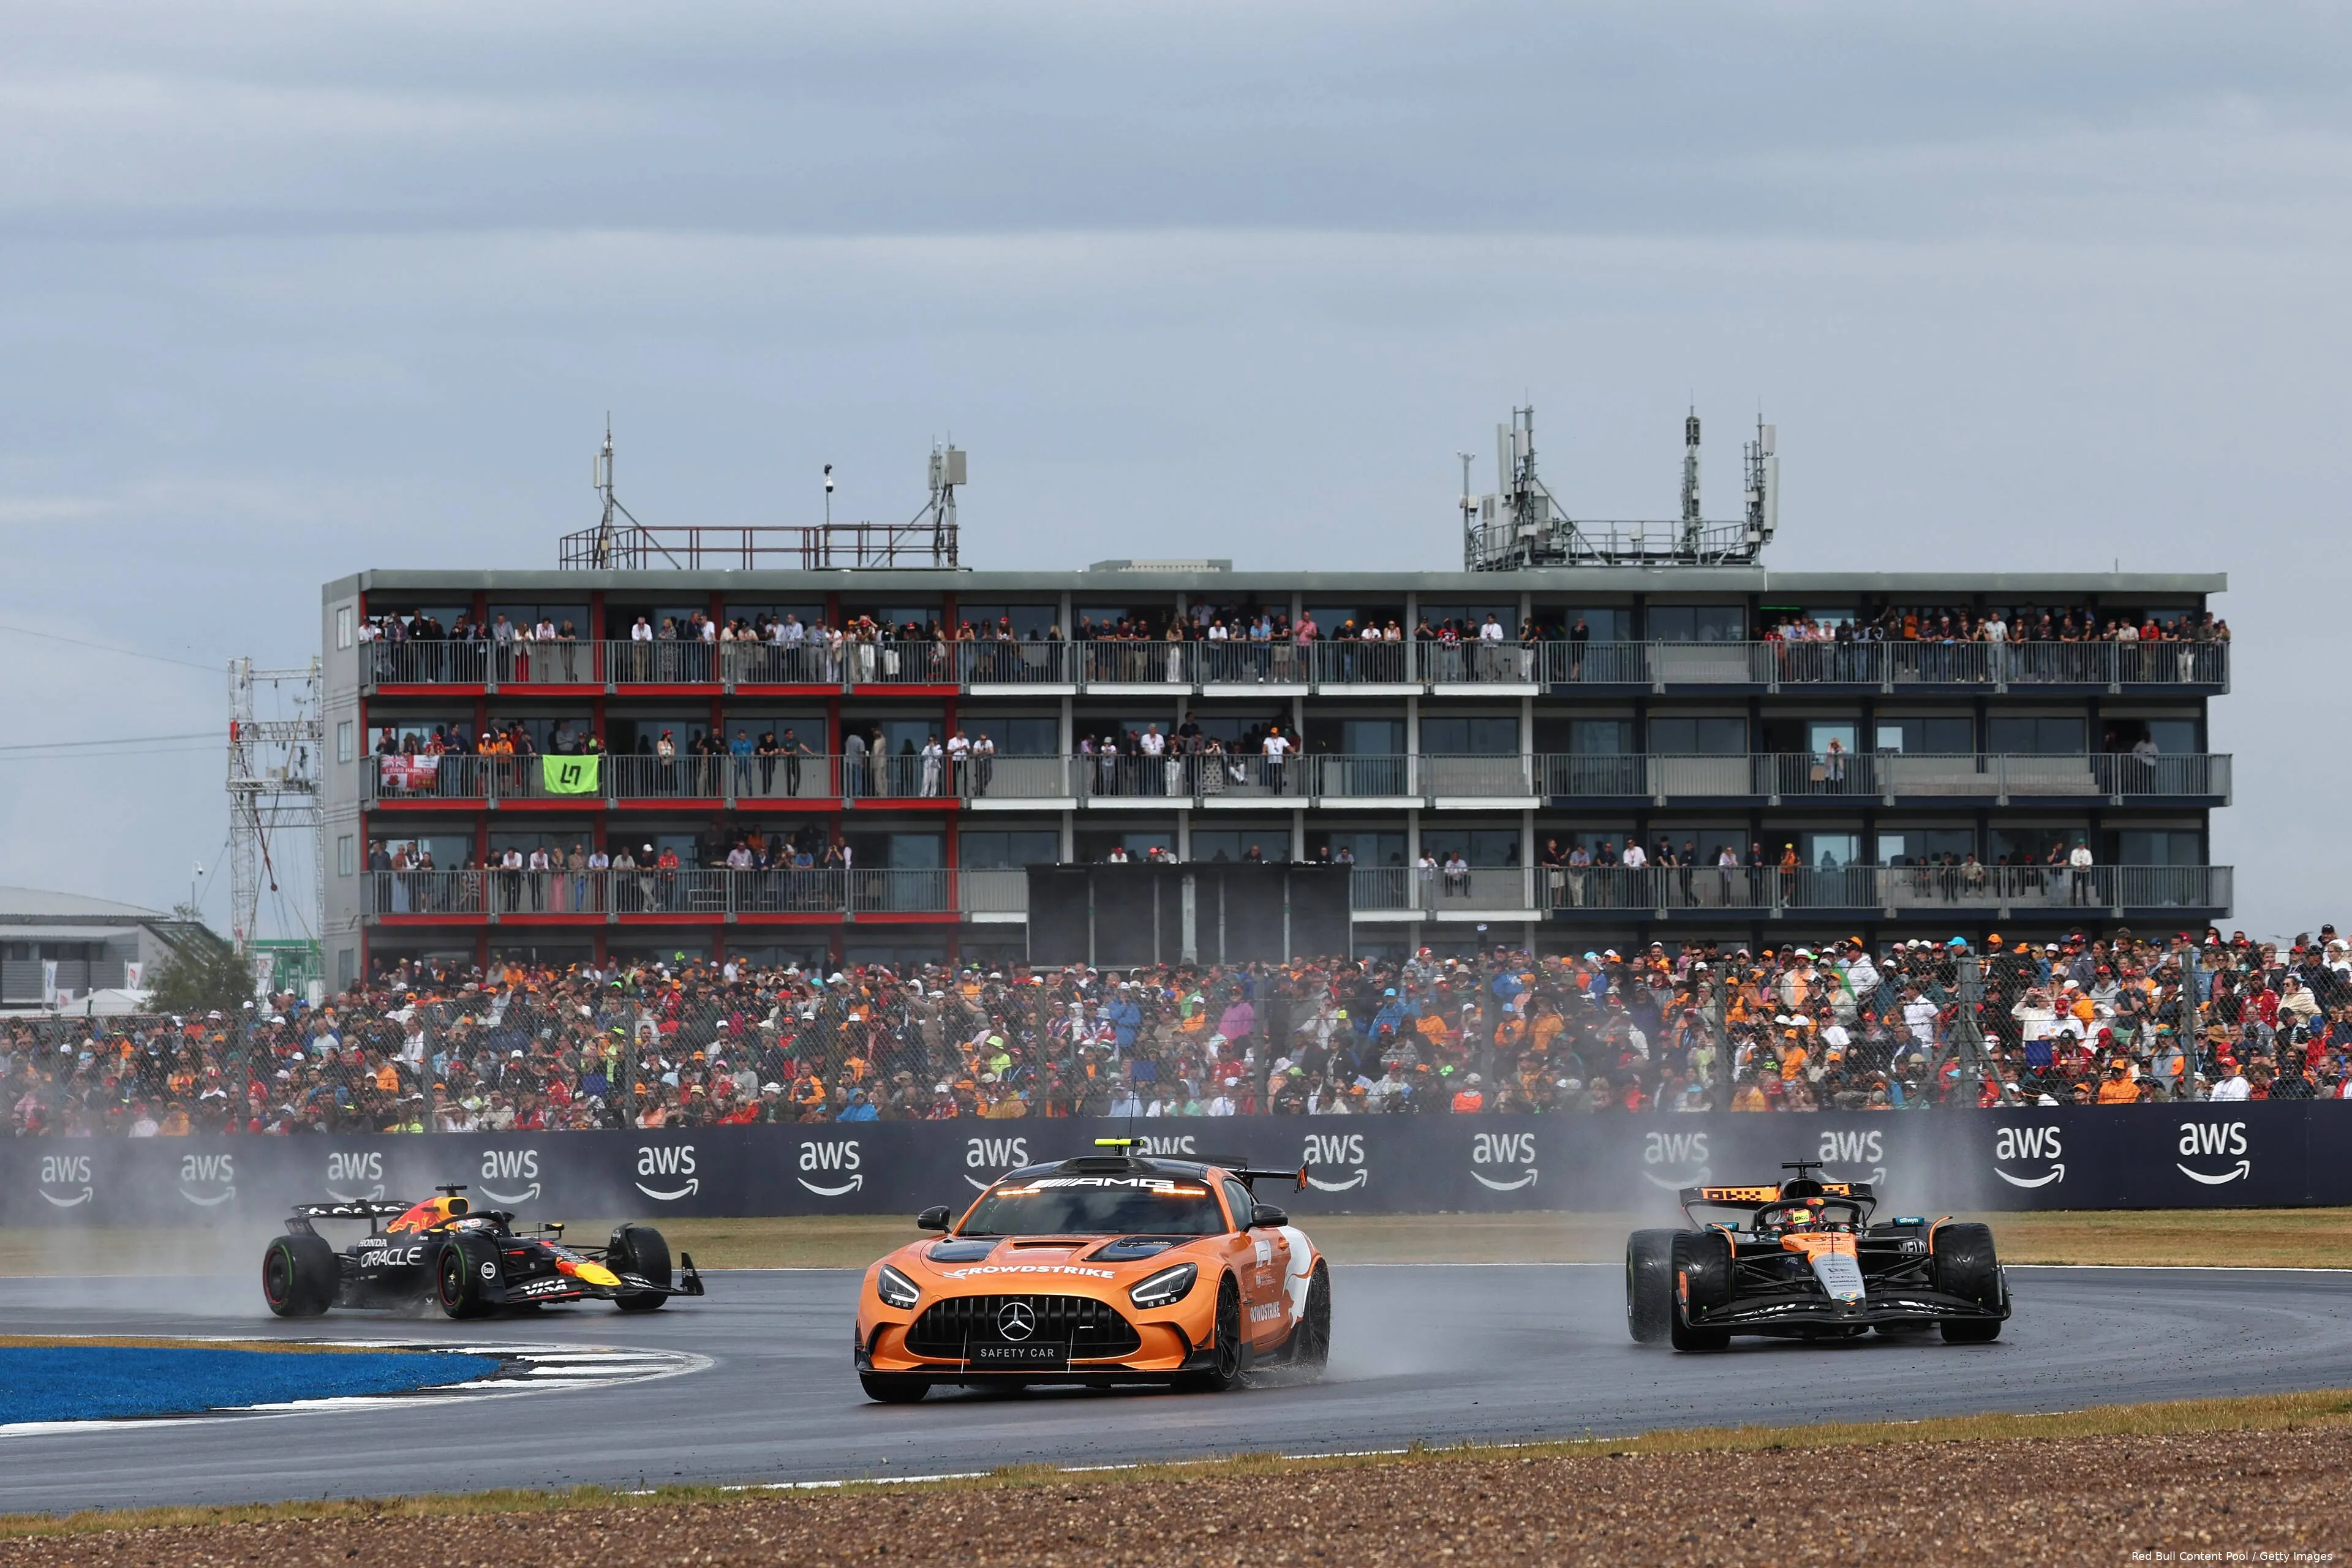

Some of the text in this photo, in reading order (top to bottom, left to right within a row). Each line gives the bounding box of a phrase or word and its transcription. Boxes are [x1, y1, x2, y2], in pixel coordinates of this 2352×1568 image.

[966, 1137, 1030, 1167] aws
[1302, 1134, 1365, 1164] aws
[1472, 1133, 1536, 1164] aws
[1644, 1131, 1709, 1163] aws
[1819, 1130, 1883, 1163] aws
[1996, 1126, 2062, 1159] aws
[2179, 1121, 2247, 1156] aws
[41, 1155, 91, 1183] aws
[181, 1154, 234, 1183] aws
[327, 1152, 383, 1181] aws
[481, 1150, 538, 1179] aws
[638, 1145, 696, 1176] aws
[799, 1140, 860, 1171] aws
[1074, 1177, 1175, 1189] AMG
[358, 1238, 388, 1247] HONDA
[360, 1246, 425, 1268] ORACLE
[521, 1278, 568, 1295] VISA
[954, 1265, 1116, 1279] CROWDSTRIKE
[1250, 1301, 1281, 1323] ROWDSTRIKE
[981, 1348, 1054, 1357] SAFETY CAR
